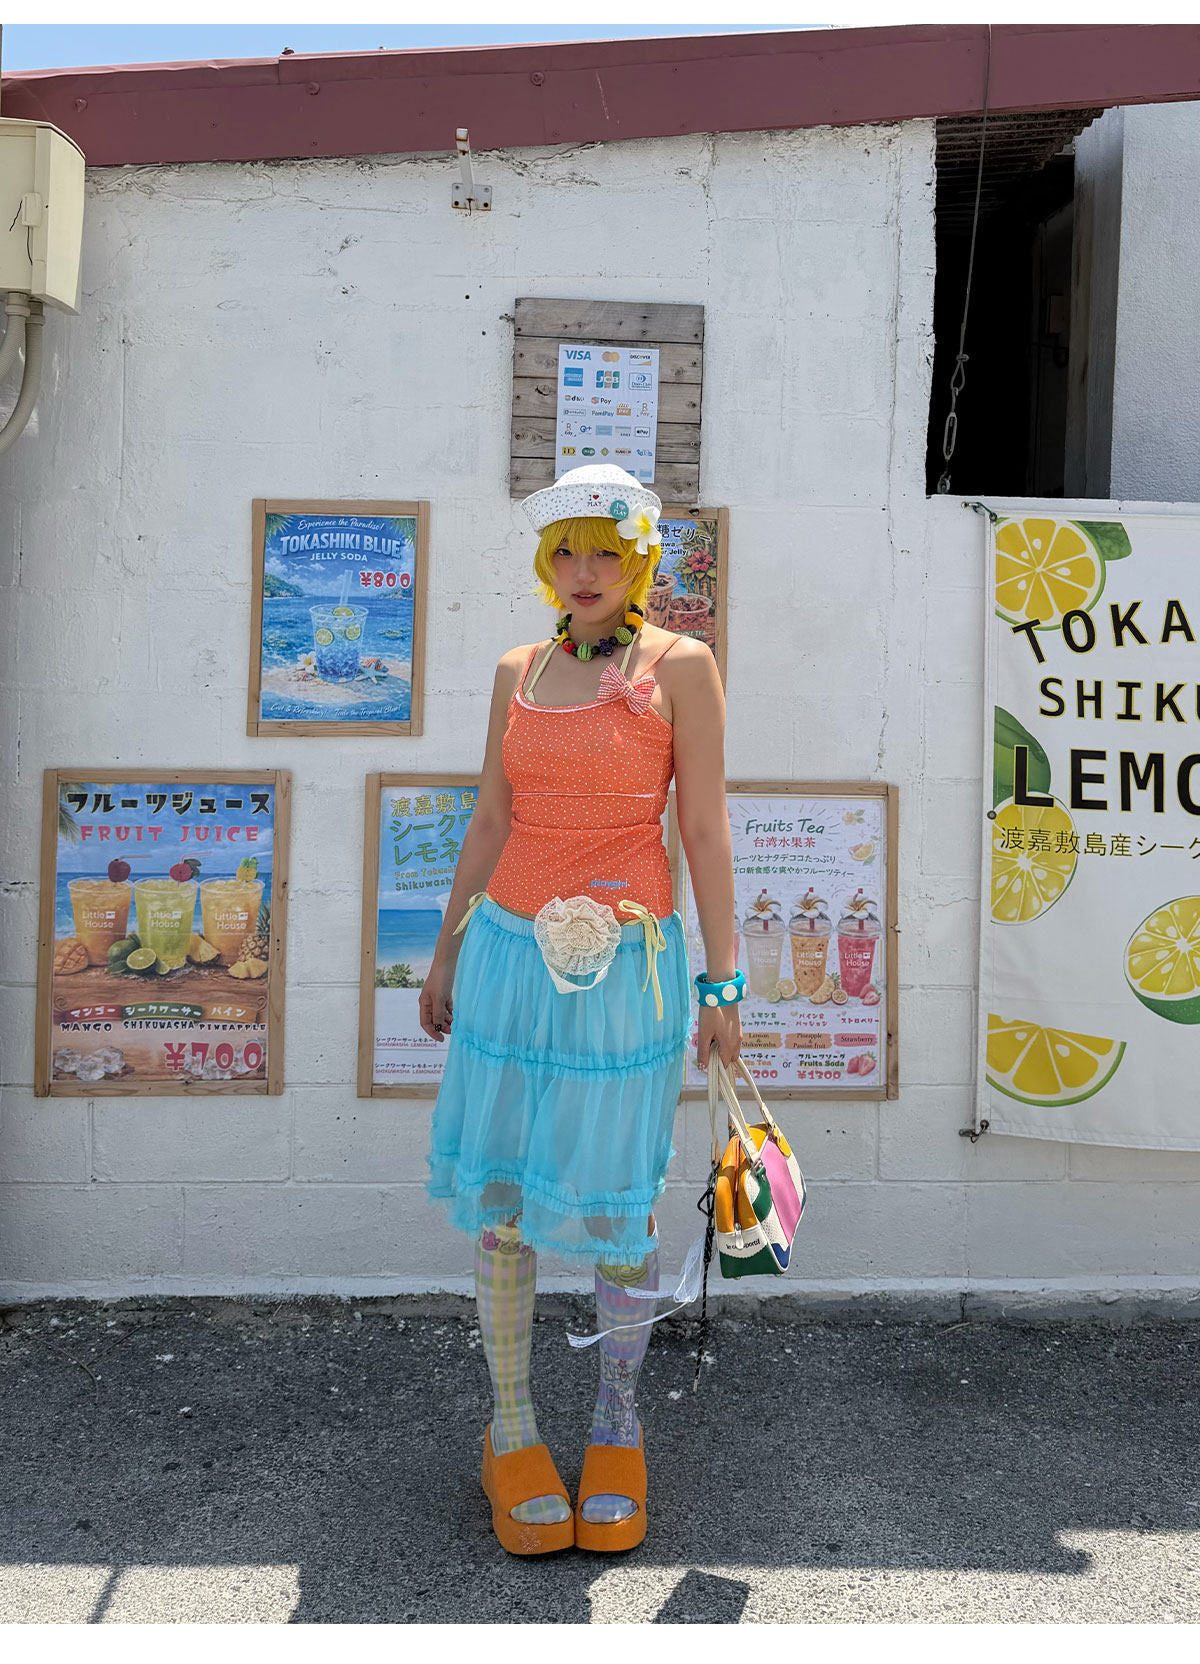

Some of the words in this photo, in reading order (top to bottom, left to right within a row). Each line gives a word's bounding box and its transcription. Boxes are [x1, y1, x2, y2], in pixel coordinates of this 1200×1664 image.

[564, 350, 591, 361] VISA
[298, 519, 336, 531] Experience
[339, 518, 348, 526] the
[349, 518, 385, 531] Paradise!
[280, 533, 361, 556] TOKASHIKI
[363, 535, 402, 559] BLUE
[310, 552, 338, 561] JELLY
[341, 552, 368, 561] SODA
[669, 549, 687, 557] Jelly
[359, 571, 411, 589] ¥800
[1011, 599, 1197, 664] TOKA
[1038, 676, 1200, 724] SHIK
[66, 791, 270, 816] フルーツジュース
[390, 792, 477, 817] 渡嘉敷島
[745, 818, 793, 835] Fruits
[798, 818, 825, 834] Tea
[79, 825, 163, 842] FRUIT
[180, 825, 259, 842] JUICE
[754, 836, 816, 848] 台湾水果茶
[394, 838, 461, 866] レモネ
[395, 871, 418, 880] From
[82, 911, 106, 919] Little
[214, 912, 239, 921] Little
[84, 920, 114, 929] House
[217, 922, 247, 930] House
[845, 952, 863, 960] Little
[70, 1007, 116, 1018] マンゴー
[211, 1006, 246, 1017] パイン
[60, 1022, 112, 1032] MANGO
[123, 1020, 195, 1030] SHIKUWASHA
[199, 1023, 266, 1031] PINEAPPLE
[164, 1042, 263, 1071] ¥700
